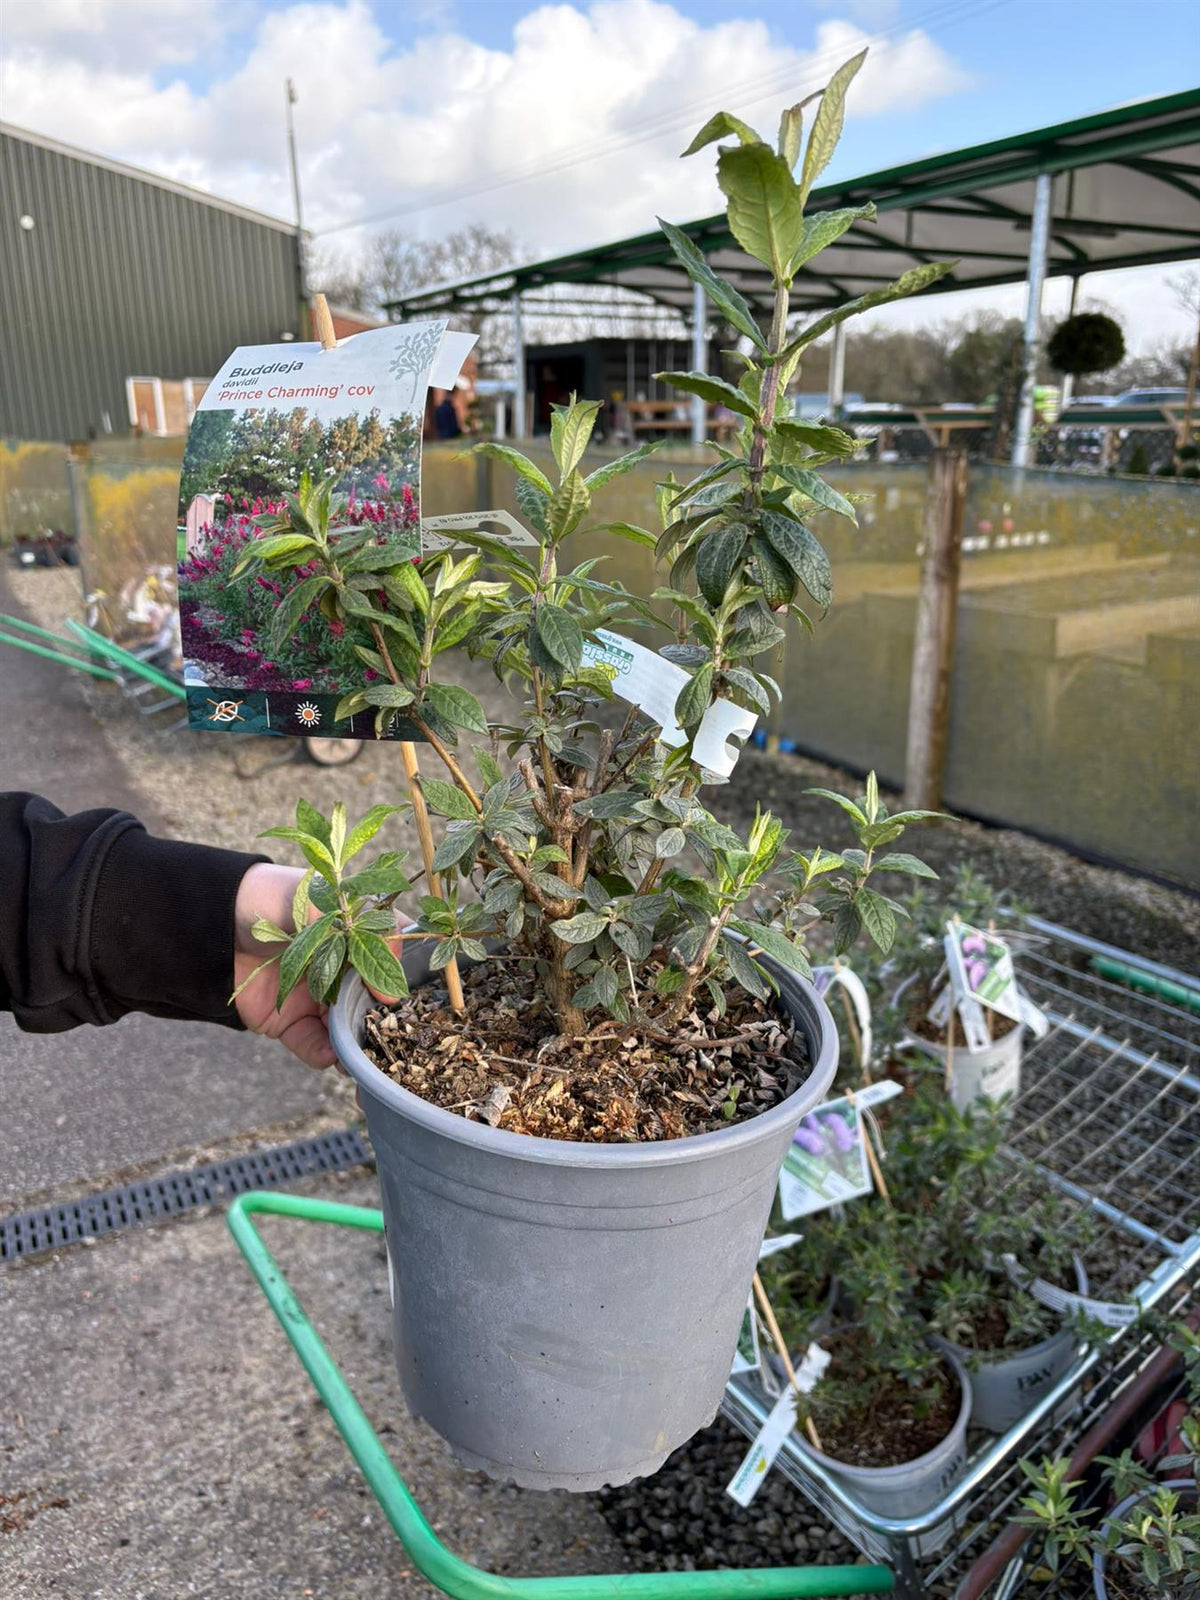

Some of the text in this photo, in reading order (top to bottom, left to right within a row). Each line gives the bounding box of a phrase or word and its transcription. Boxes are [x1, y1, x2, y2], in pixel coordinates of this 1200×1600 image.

[229, 361, 304, 378] Buddleja
[222, 377, 259, 388] davidii
[217, 384, 375, 401] 'Prince Charming' cov
